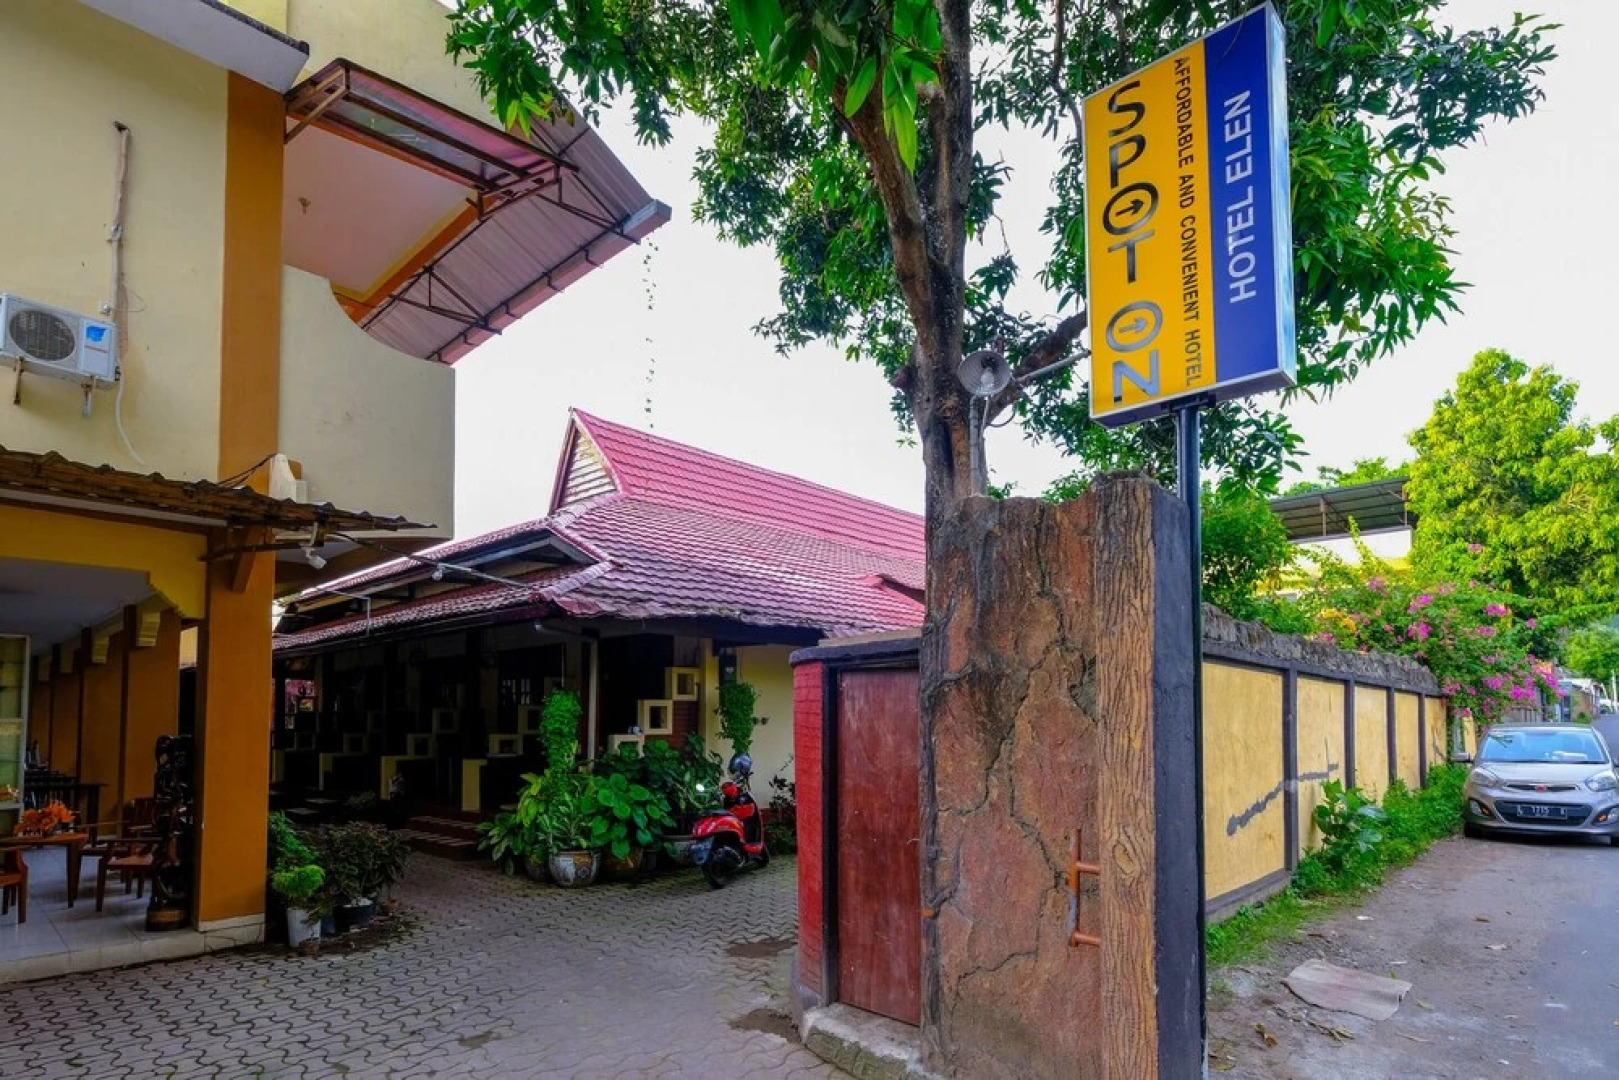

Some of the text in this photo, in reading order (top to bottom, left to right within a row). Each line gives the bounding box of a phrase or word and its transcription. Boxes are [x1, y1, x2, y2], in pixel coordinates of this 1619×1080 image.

[1103, 80, 1162, 406] SPOT ON
[1174, 57, 1202, 386] AFFORDABLE AND CONVENIENT HOTEL
[1224, 90, 1256, 303] HOTEL ELEN
